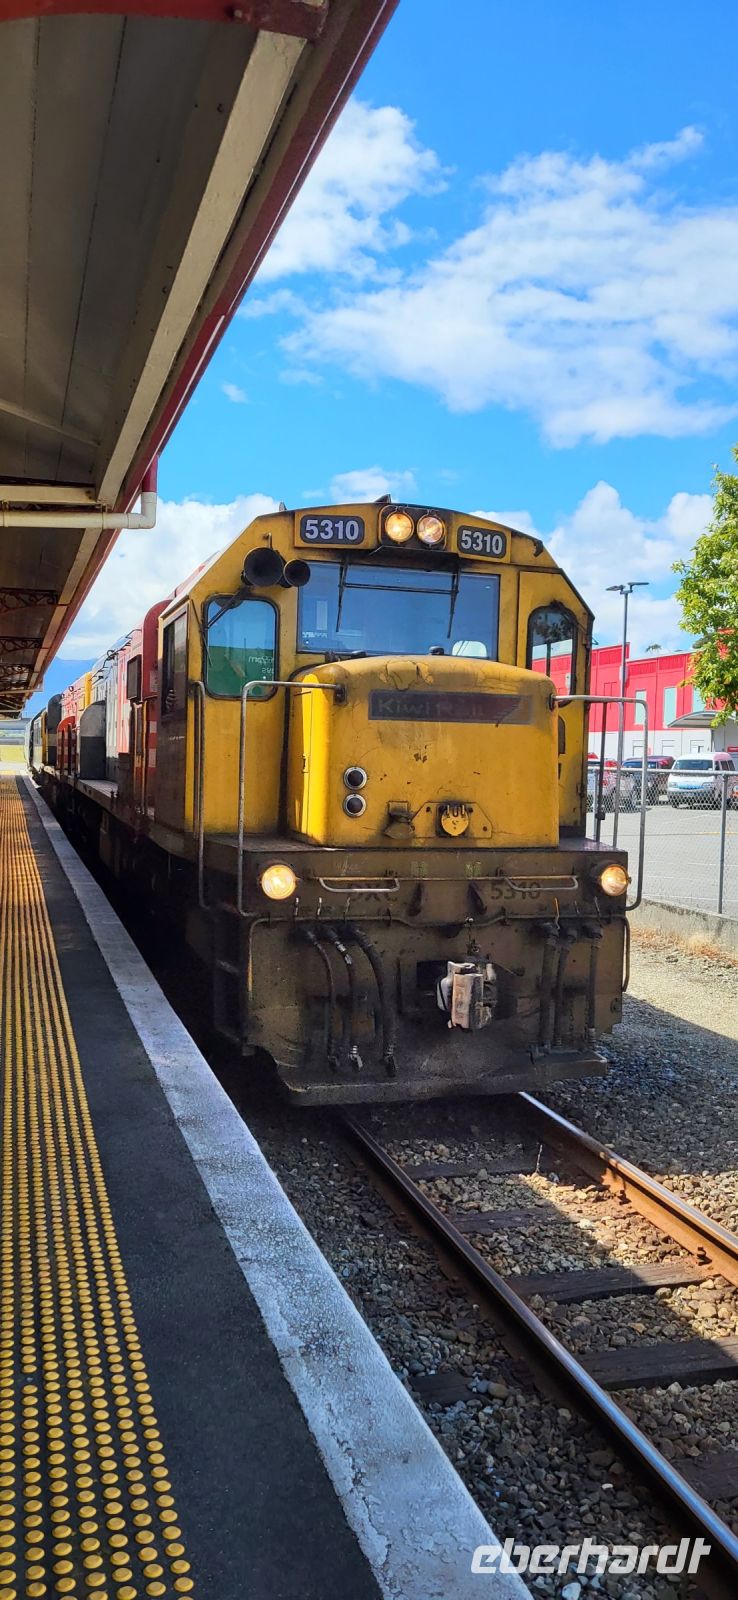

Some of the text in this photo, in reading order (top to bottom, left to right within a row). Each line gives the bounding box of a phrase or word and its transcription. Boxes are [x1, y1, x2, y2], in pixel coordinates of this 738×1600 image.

[304, 519, 360, 541] 5310
[460, 529, 504, 555] 5310
[489, 881, 542, 900] 5310
